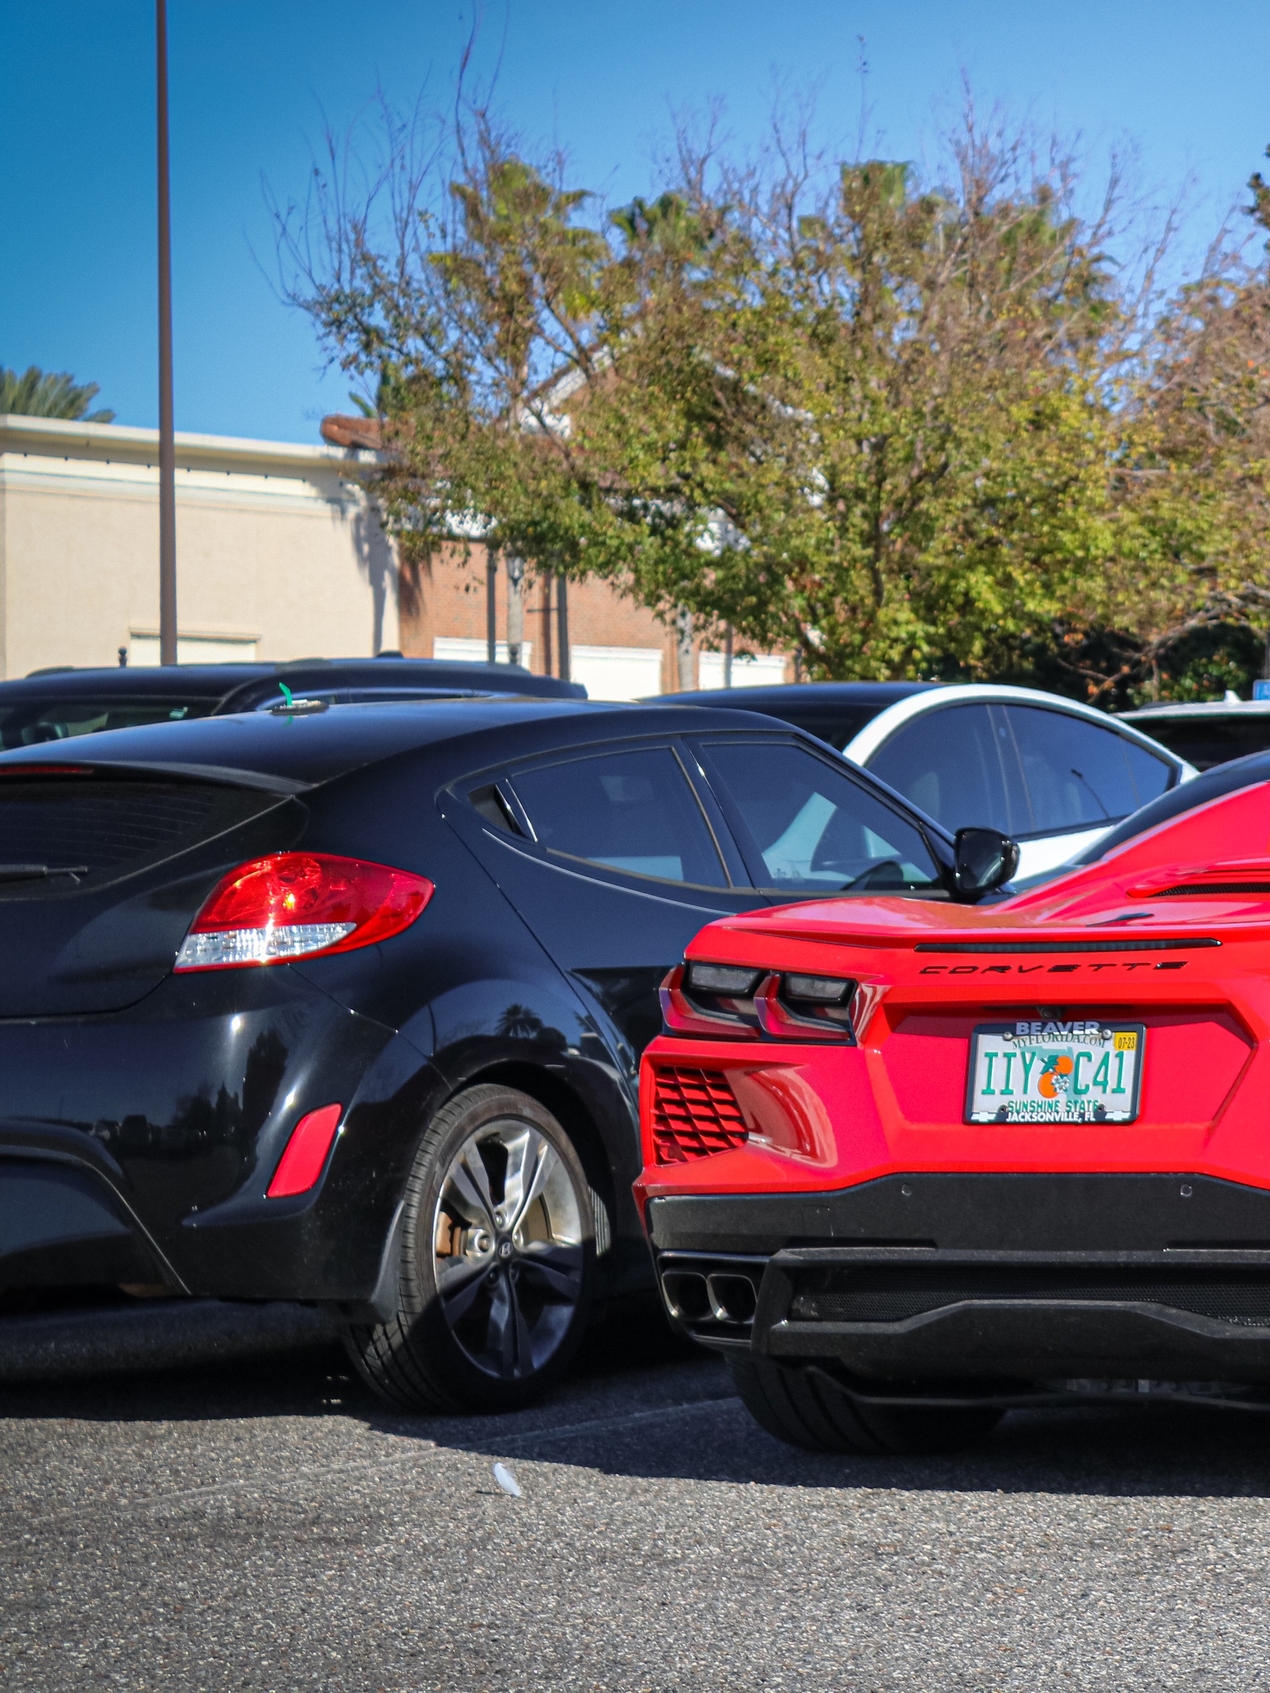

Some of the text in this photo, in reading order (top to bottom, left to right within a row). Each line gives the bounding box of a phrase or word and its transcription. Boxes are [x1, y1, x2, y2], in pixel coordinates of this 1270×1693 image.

[919, 961, 1189, 975] CORVETTE
[1015, 1021, 1100, 1035] BEAVER
[1118, 1037, 1135, 1049] 07-23
[981, 1050, 1127, 1096] IIY C41
[1007, 1100, 1099, 1113] SUNSHINE STATE
[1006, 1112, 1096, 1123] JACKSONVILLE, FL
